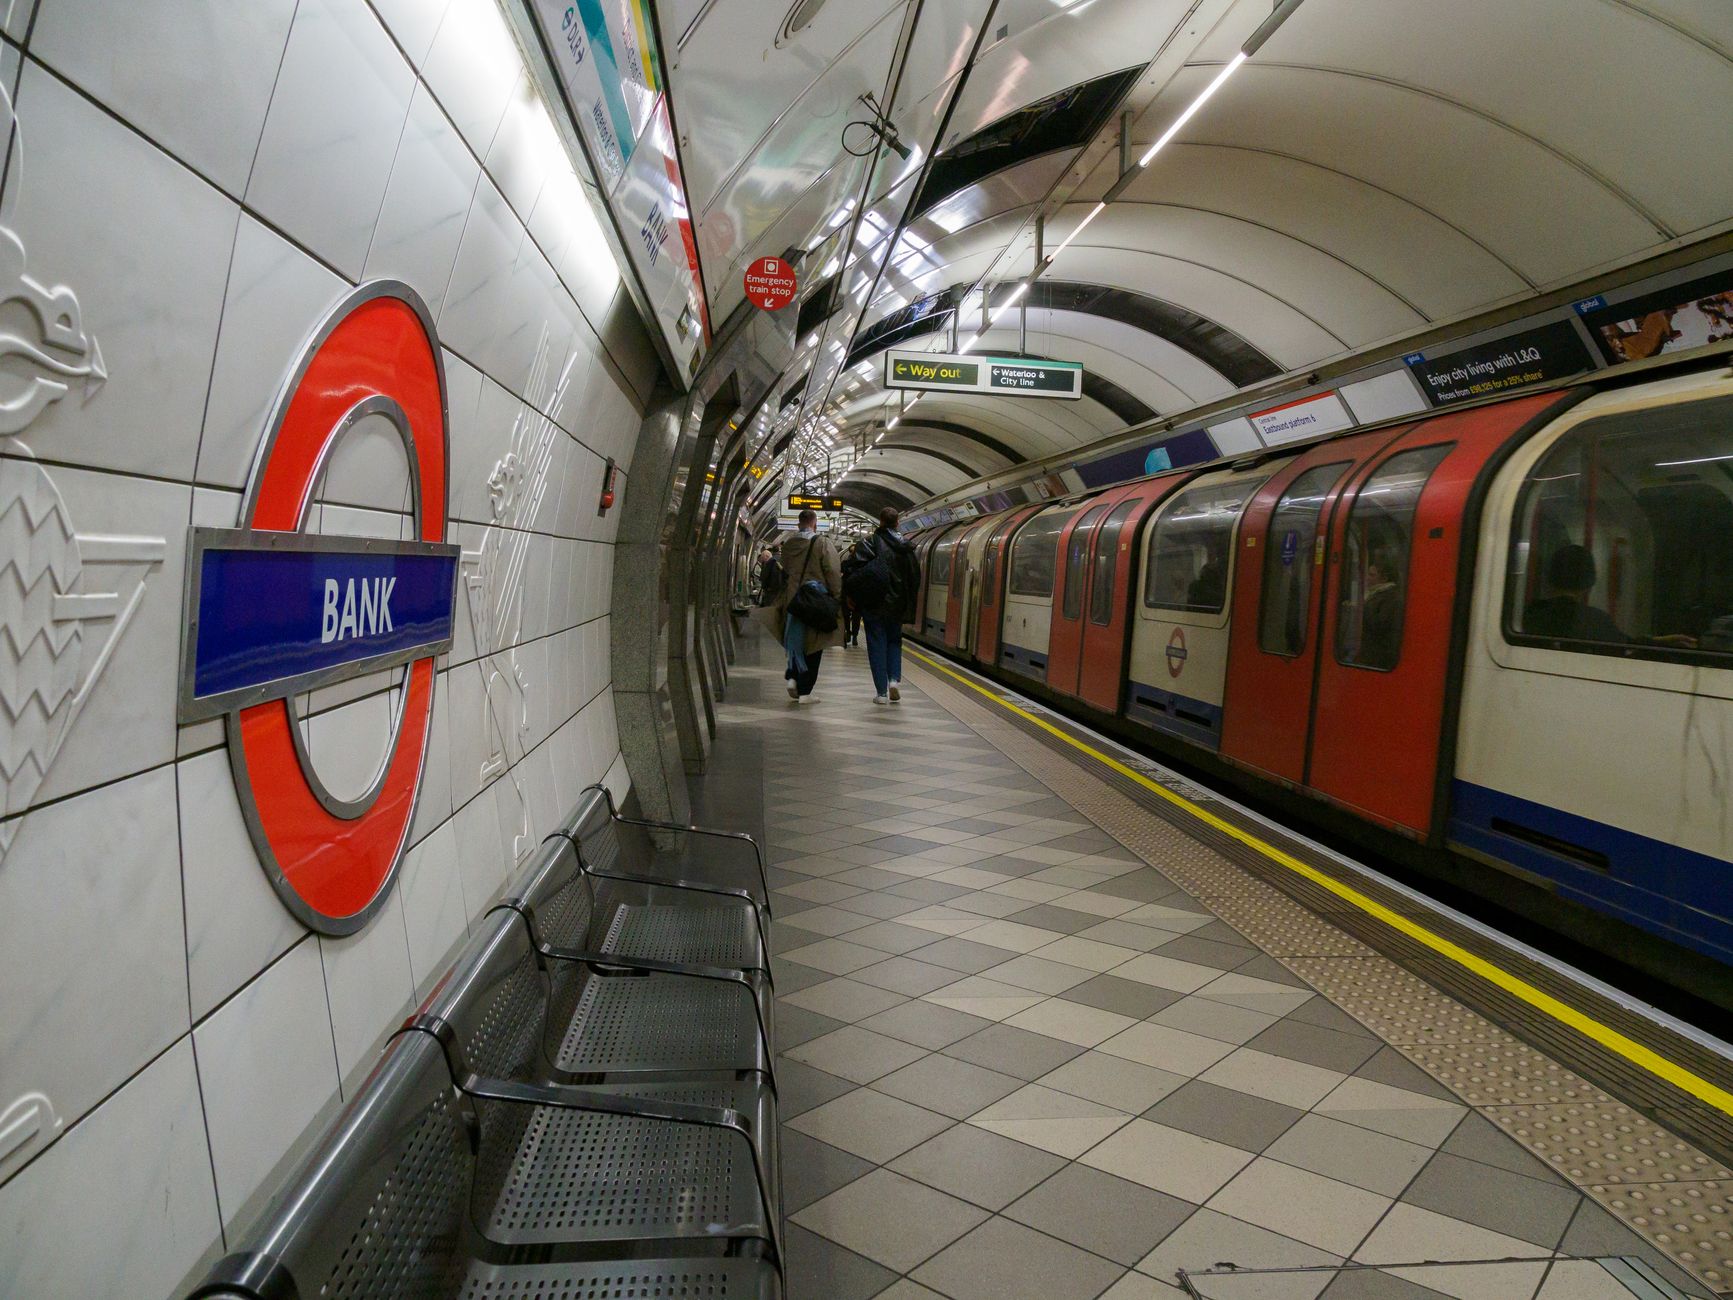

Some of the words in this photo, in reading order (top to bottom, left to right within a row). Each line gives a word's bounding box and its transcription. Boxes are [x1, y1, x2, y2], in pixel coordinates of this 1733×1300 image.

[567, 21, 582, 57] DLR
[746, 274, 794, 287] Emergency
[749, 285, 769, 294] train
[771, 287, 791, 297] stop
[1580, 299, 1600, 313] global
[910, 364, 936, 379] Way
[940, 367, 961, 378] out
[1001, 368, 1037, 379] Waterloo
[1038, 371, 1046, 379] &
[1427, 372, 1452, 387] Enjoy
[1451, 367, 1469, 380] city
[1466, 361, 1496, 375] living
[1493, 353, 1517, 369] with
[1513, 347, 1542, 364] L&Q
[1000, 377, 1018, 387] City
[1019, 378, 1035, 387] line
[1437, 391, 1457, 401] Prices
[1454, 388, 1471, 398] from
[1492, 379, 1503, 389] for
[1263, 422, 1290, 434] Eastbound
[1288, 416, 1312, 429] platform
[321, 576, 397, 644] BANK
